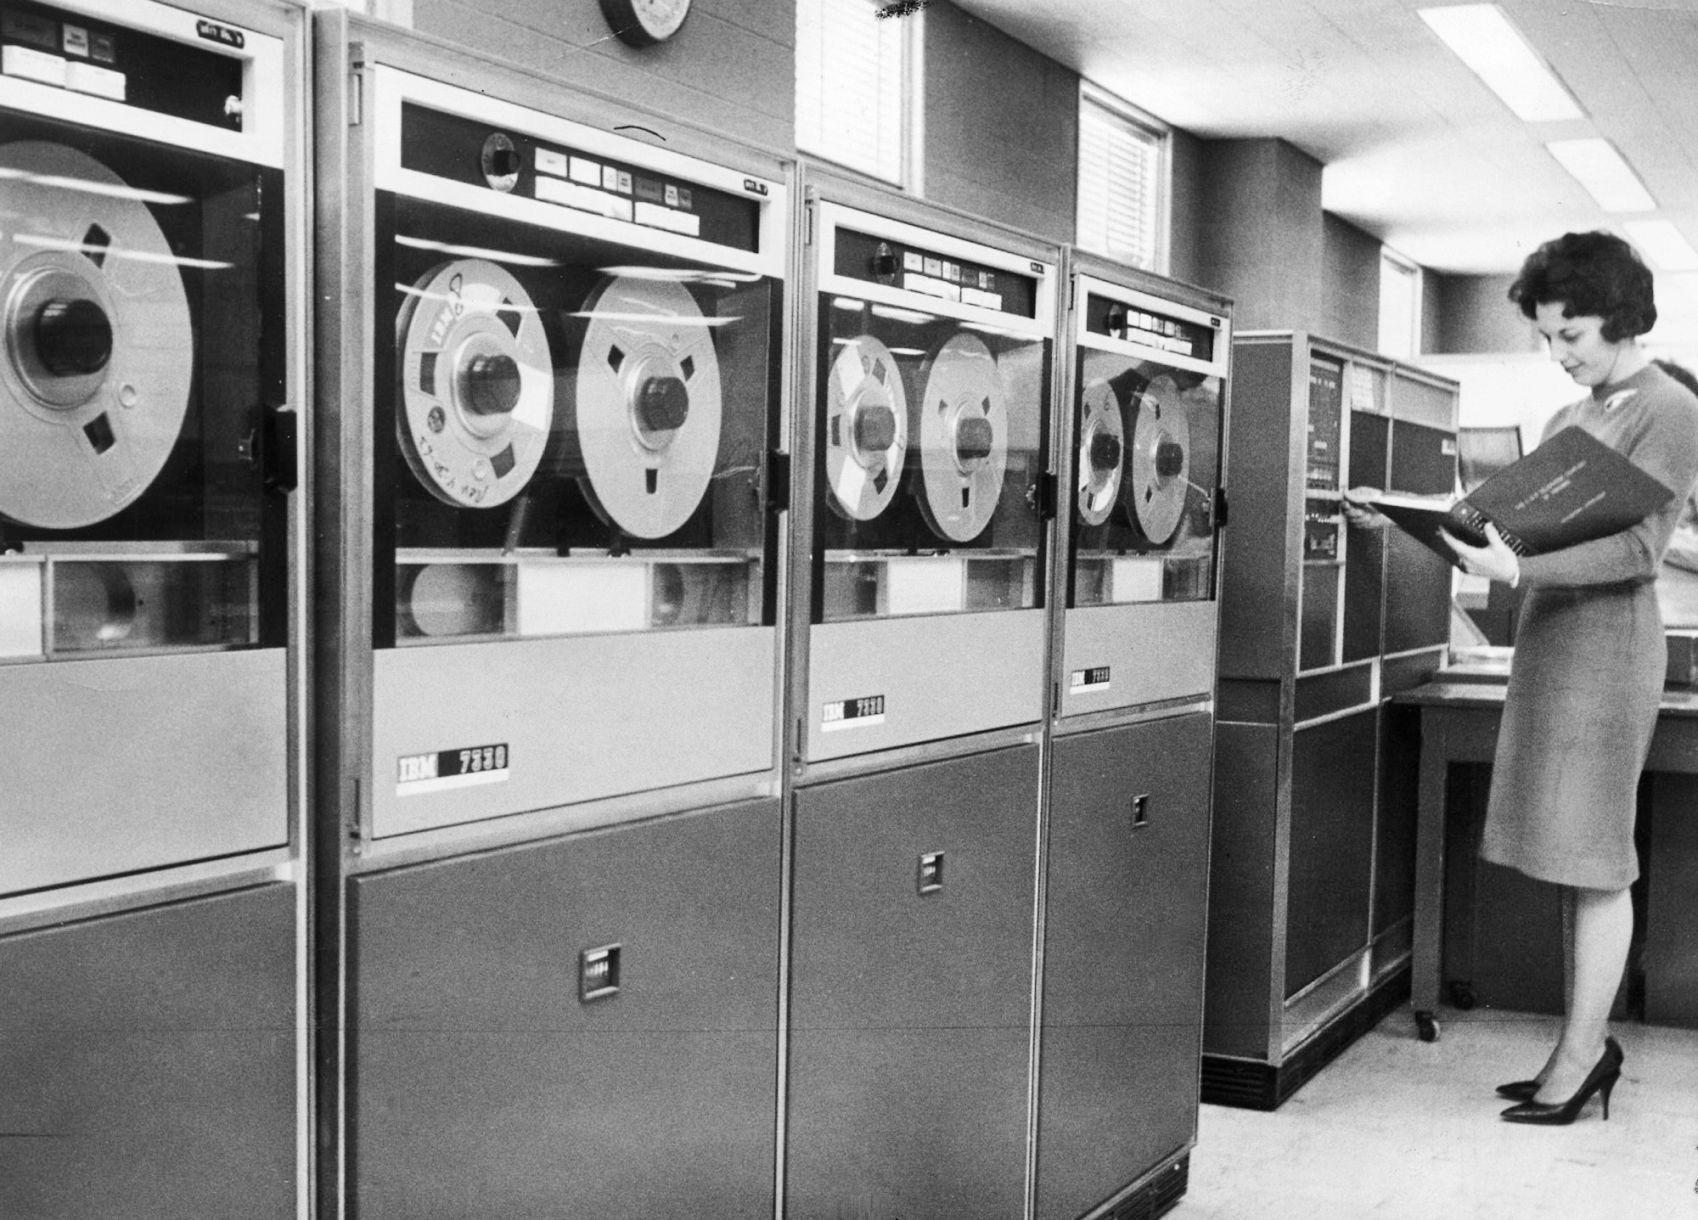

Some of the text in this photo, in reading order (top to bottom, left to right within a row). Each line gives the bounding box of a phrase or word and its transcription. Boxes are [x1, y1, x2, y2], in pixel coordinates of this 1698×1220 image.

[430, 306, 454, 346] IBM
[399, 744, 506, 782] IBM 7330
